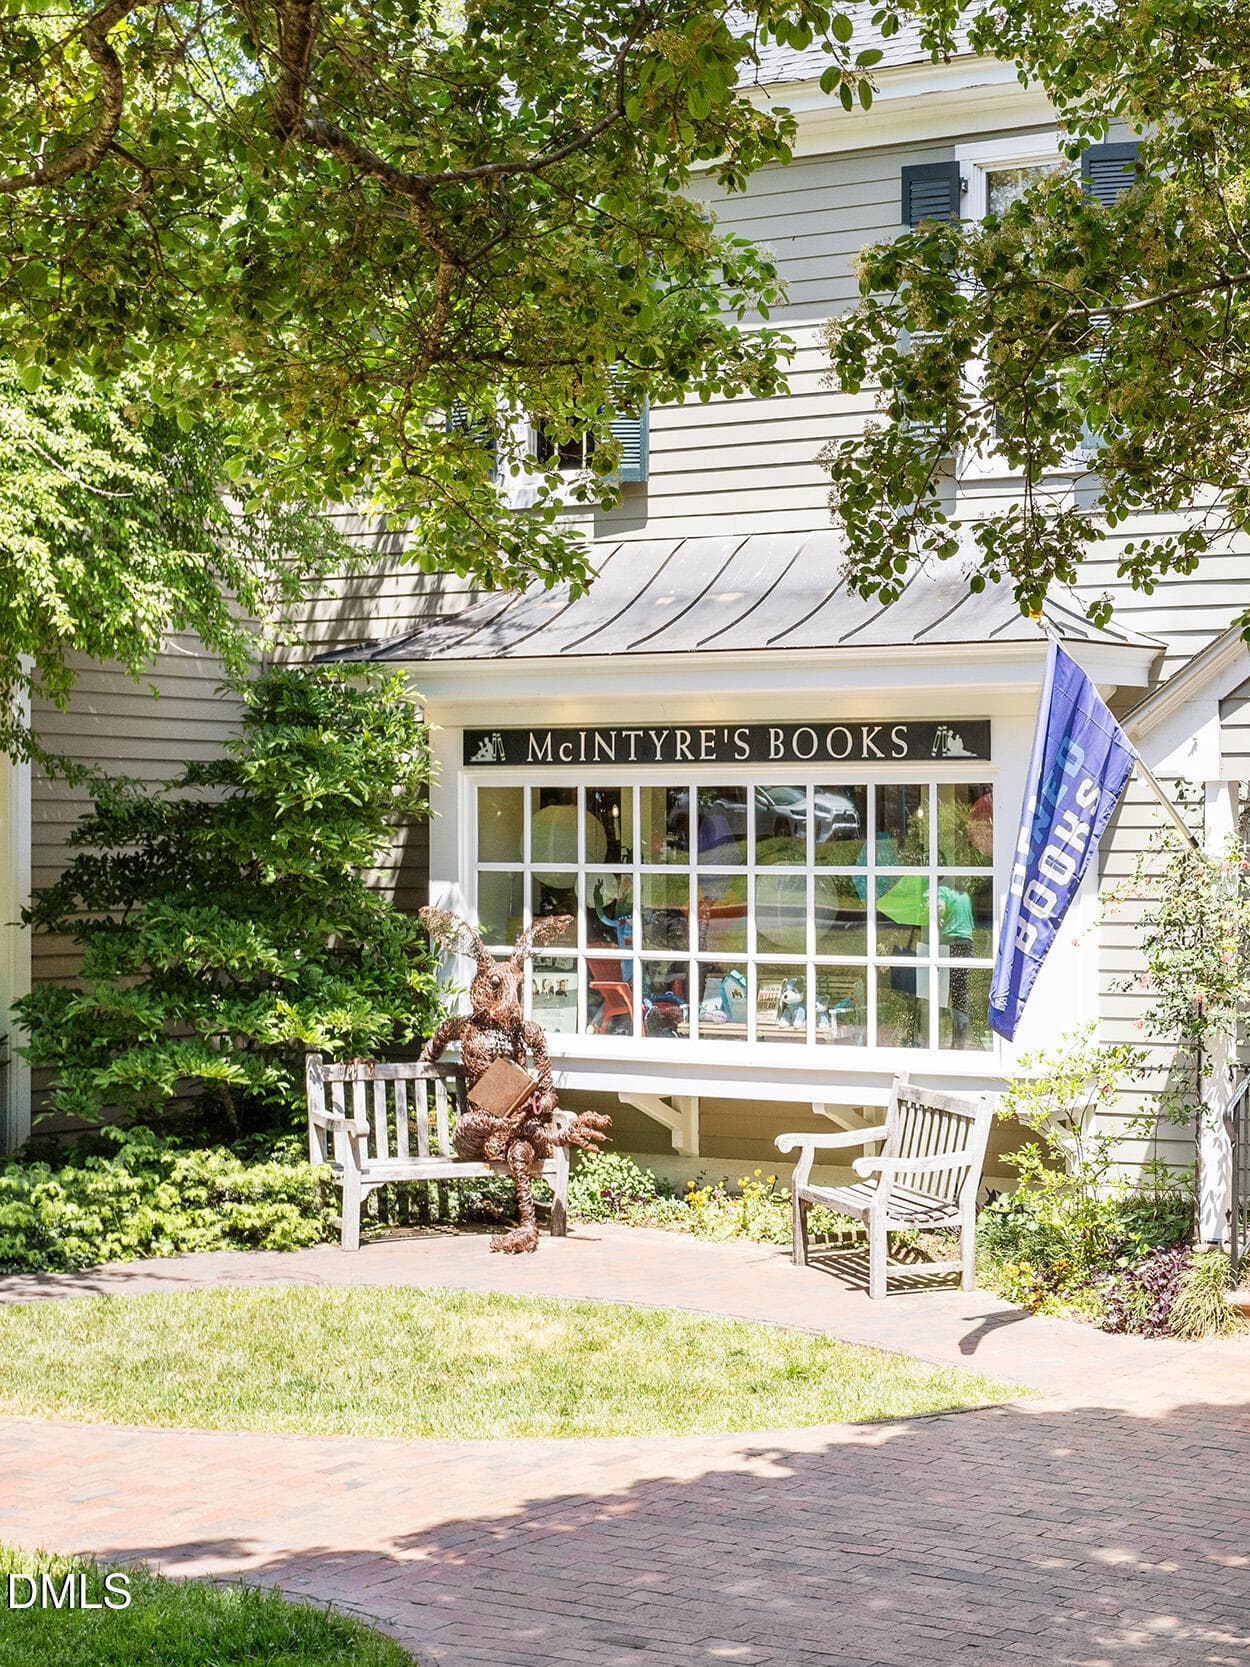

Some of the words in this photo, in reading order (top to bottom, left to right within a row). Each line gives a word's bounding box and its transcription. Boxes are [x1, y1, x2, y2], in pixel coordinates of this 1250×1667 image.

[527, 726, 751, 763] McINTYRE'S
[768, 724, 910, 760] BOOKS
[1015, 777, 1101, 956] BOOKS
